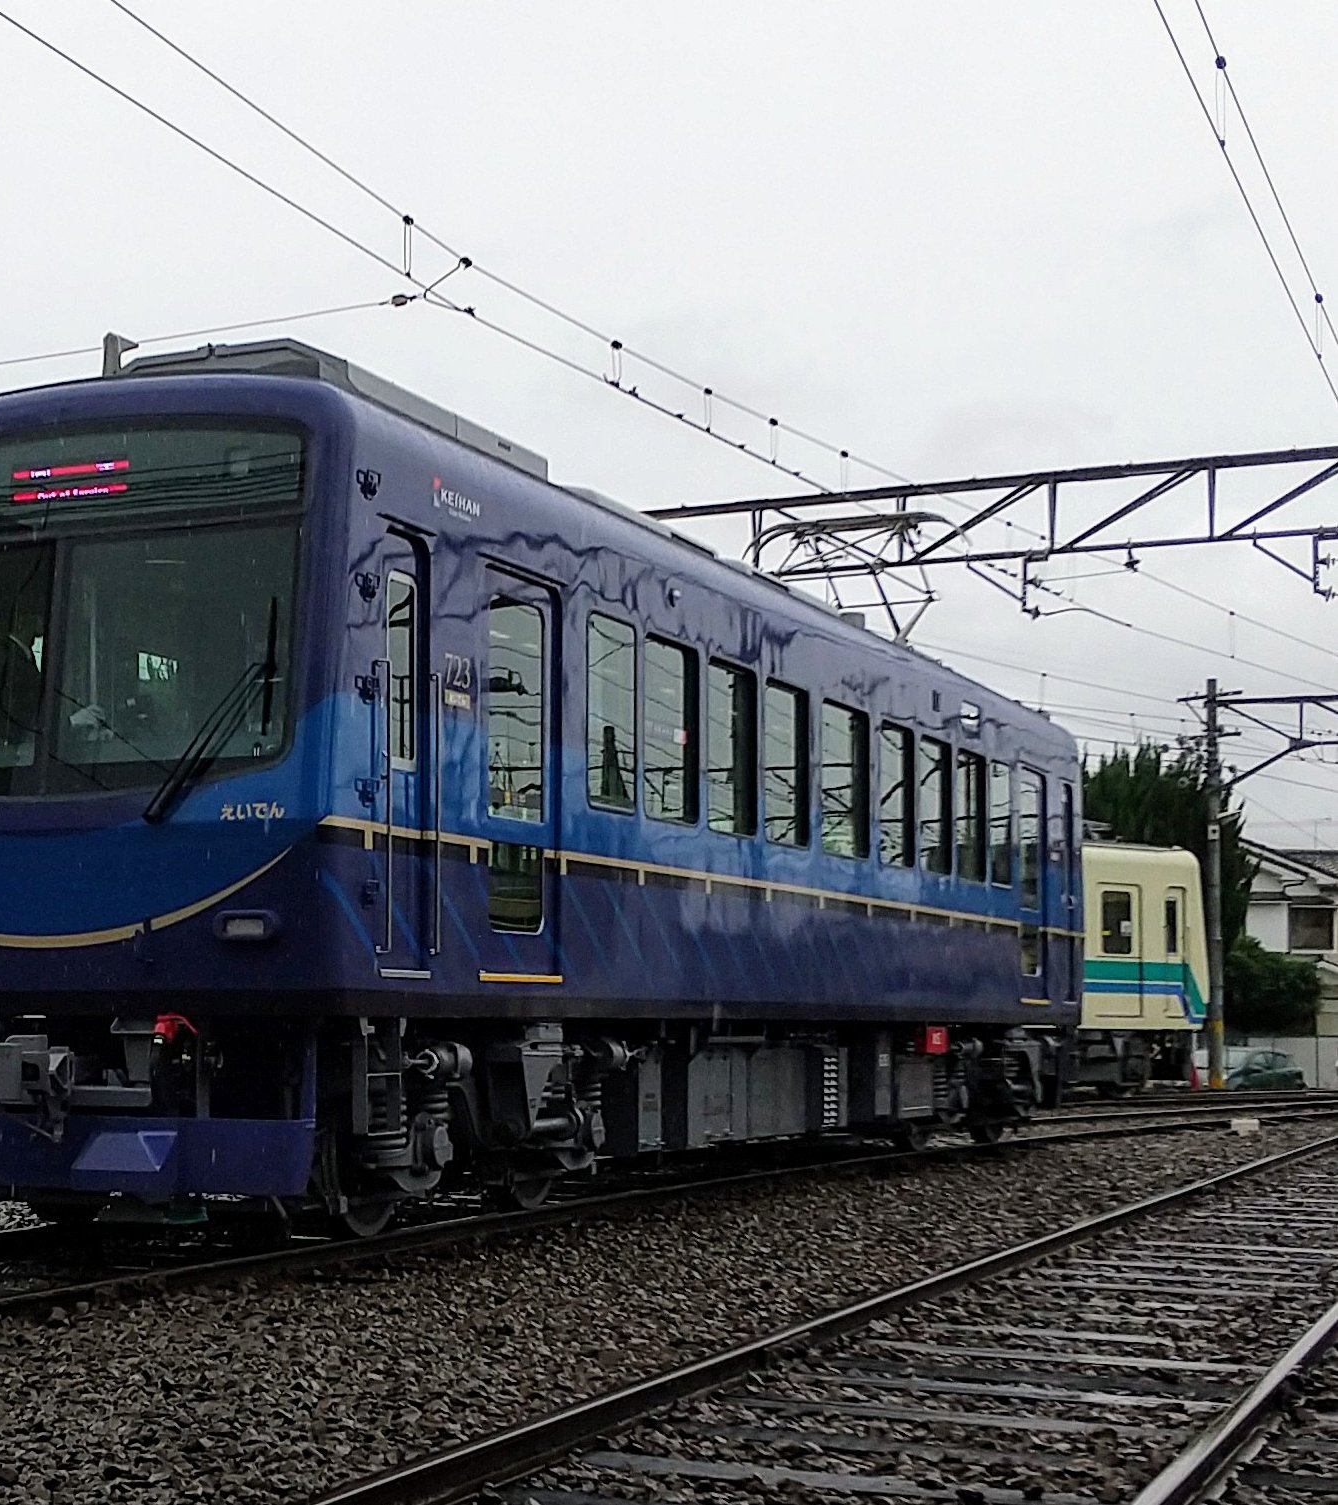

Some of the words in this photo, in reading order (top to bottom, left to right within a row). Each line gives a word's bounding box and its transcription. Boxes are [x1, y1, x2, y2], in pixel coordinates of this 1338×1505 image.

[440, 488, 480, 517] KEIHAN
[444, 652, 471, 689] 723
[220, 801, 285, 821] えいでん
